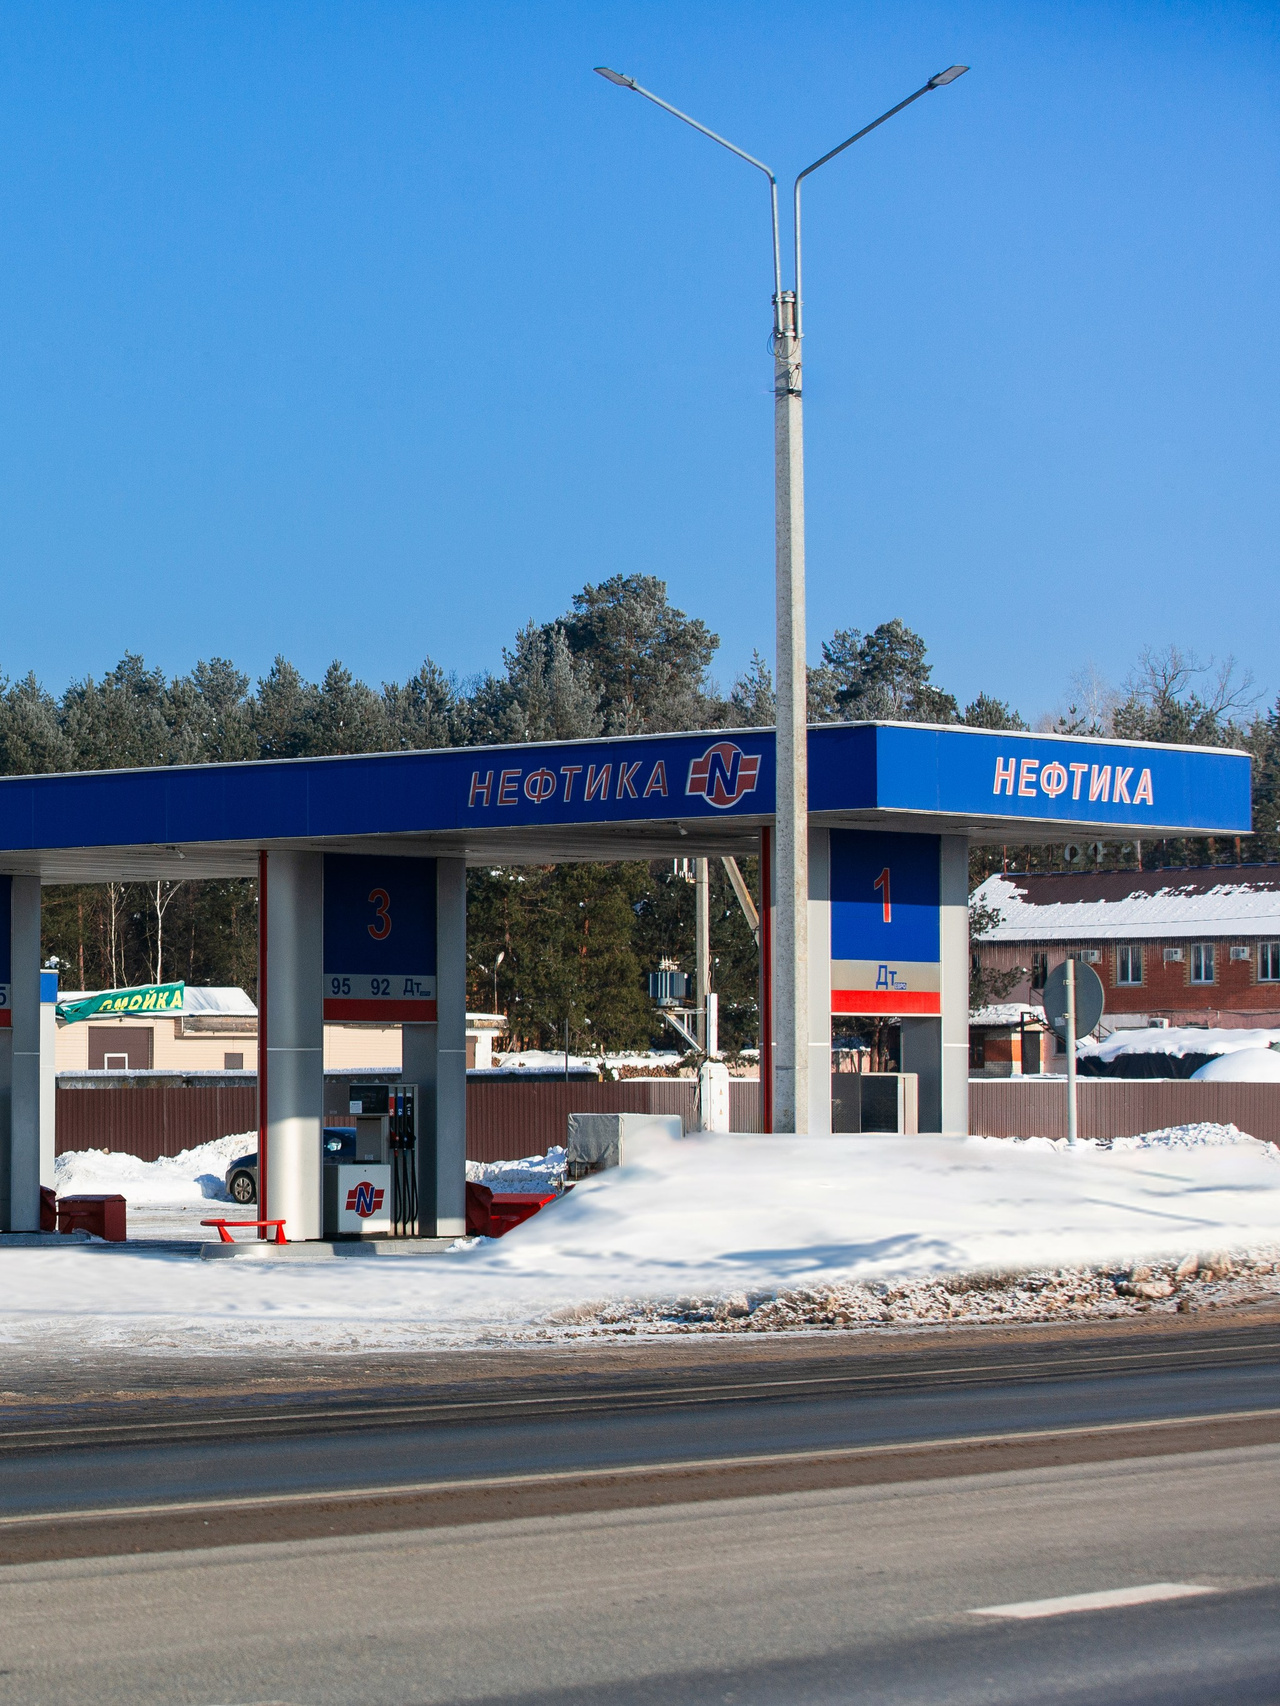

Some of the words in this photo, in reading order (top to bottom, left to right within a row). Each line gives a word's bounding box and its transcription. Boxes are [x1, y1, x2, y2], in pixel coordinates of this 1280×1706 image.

[468, 760, 669, 808] НЕФТИКА
[993, 756, 1154, 806] НЕФТИКА
[367, 887, 392, 941] 3
[873, 867, 892, 923] 1
[331, 977, 351, 996] 95
[371, 978, 391, 996] 92
[402, 978, 422, 996] Дт
[875, 964, 898, 990] Дт
